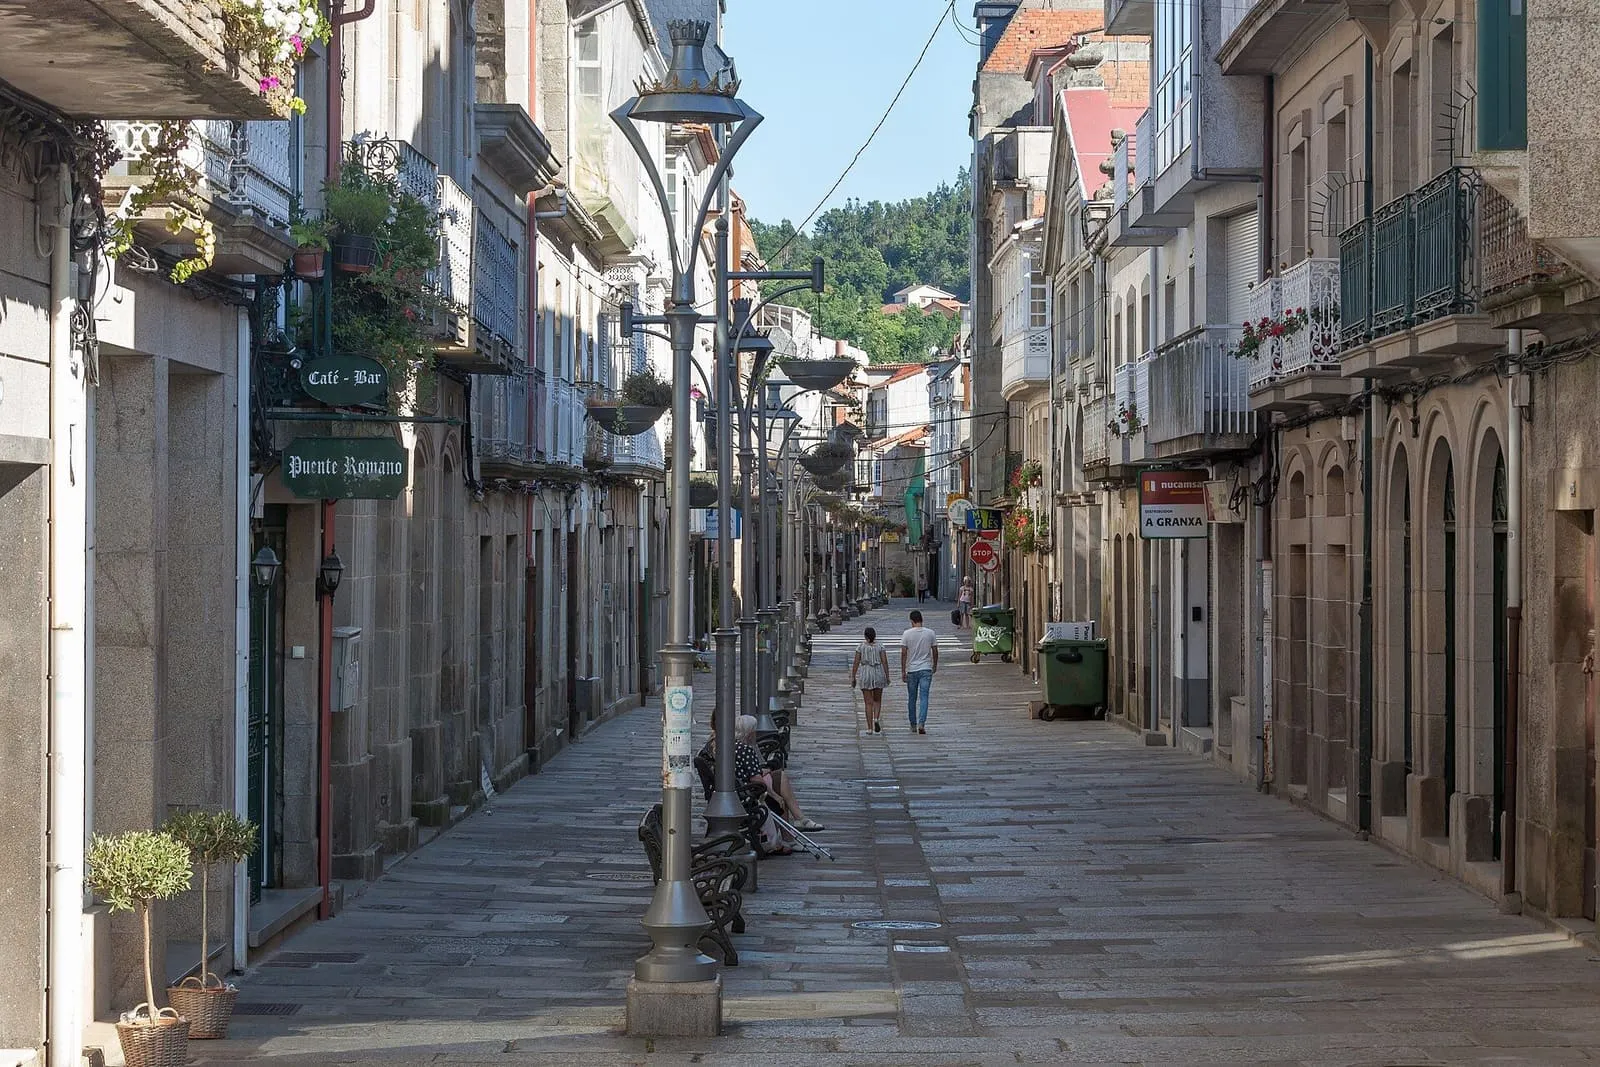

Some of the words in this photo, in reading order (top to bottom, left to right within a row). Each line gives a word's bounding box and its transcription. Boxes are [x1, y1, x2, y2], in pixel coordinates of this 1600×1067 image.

[308, 370, 339, 385] Café
[353, 370, 381, 386] Bar
[288, 455, 338, 479] Puente
[343, 455, 403, 476] Romano
[1145, 518, 1154, 526] A
[1156, 518, 1202, 526] GRANXA
